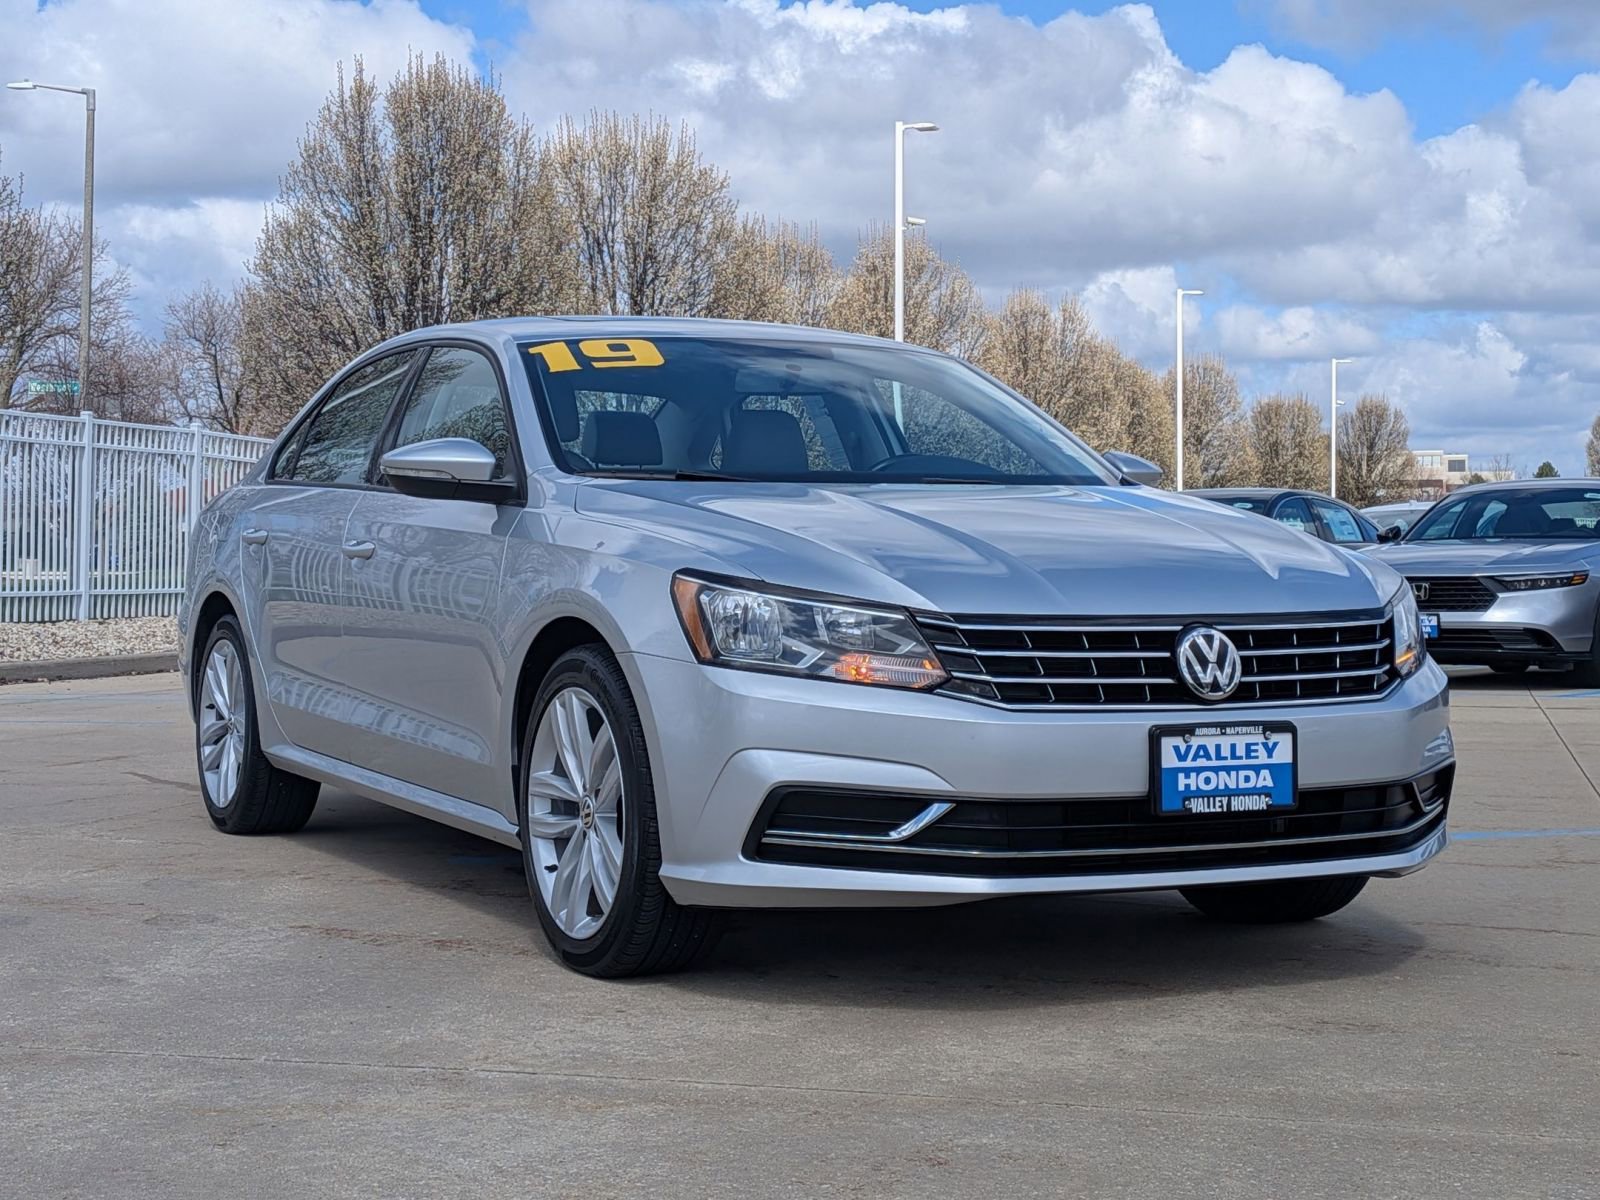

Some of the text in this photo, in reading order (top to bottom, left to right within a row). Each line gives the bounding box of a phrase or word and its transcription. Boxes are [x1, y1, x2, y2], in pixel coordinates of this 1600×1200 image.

[528, 339, 665, 373] 19
[1195, 726, 1263, 735] AURORA NAPERVILLE
[1172, 741, 1280, 762] VALLEY
[1178, 769, 1274, 791] HONDA
[1191, 794, 1267, 813] VALLEY HONDA
